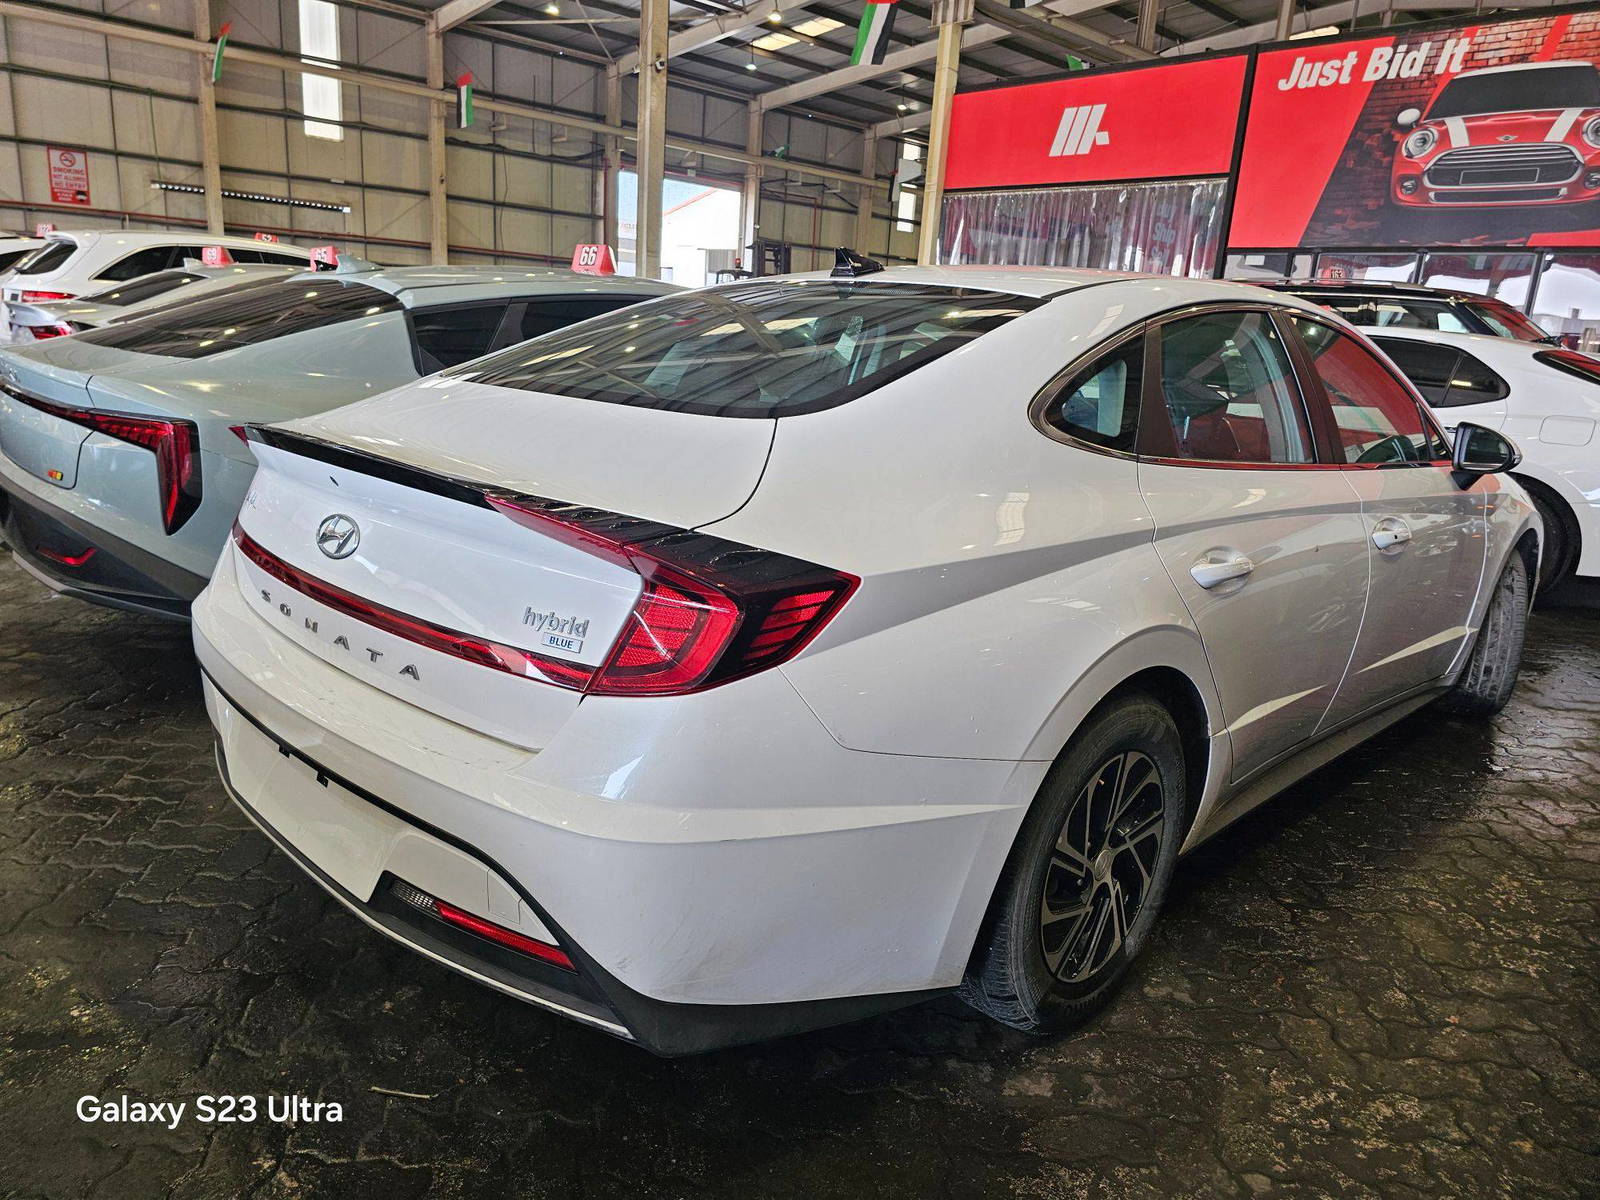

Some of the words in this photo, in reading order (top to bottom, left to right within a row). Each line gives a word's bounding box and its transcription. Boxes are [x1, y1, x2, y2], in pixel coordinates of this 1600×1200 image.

[1278, 51, 1359, 91] Just
[1362, 42, 1432, 82] Bid
[1434, 36, 1472, 75] It
[53, 166, 85, 175] SMOKING
[579, 246, 599, 266] 66
[1331, 269, 1344, 279] 163
[522, 606, 590, 638] hybrid
[261, 589, 421, 681] SONATA
[549, 636, 574, 649] BLUE
